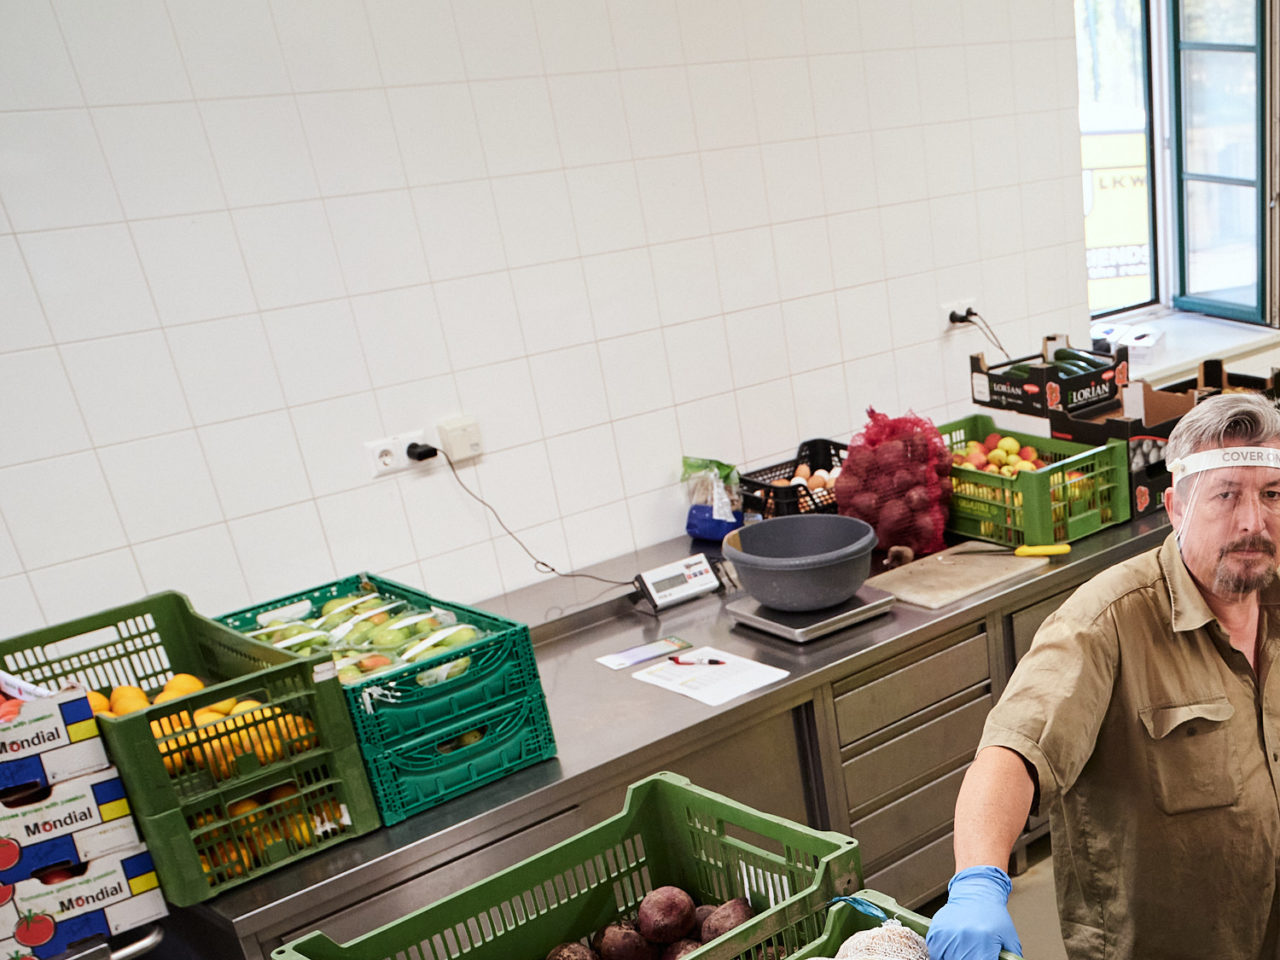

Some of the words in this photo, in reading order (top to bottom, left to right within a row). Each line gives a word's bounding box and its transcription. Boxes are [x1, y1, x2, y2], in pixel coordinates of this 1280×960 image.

[1067, 380, 1111, 405] FLORIAN
[1222, 451, 1264, 463] COVER
[24, 807, 93, 837] Mondial
[58, 882, 124, 912] Mondial
